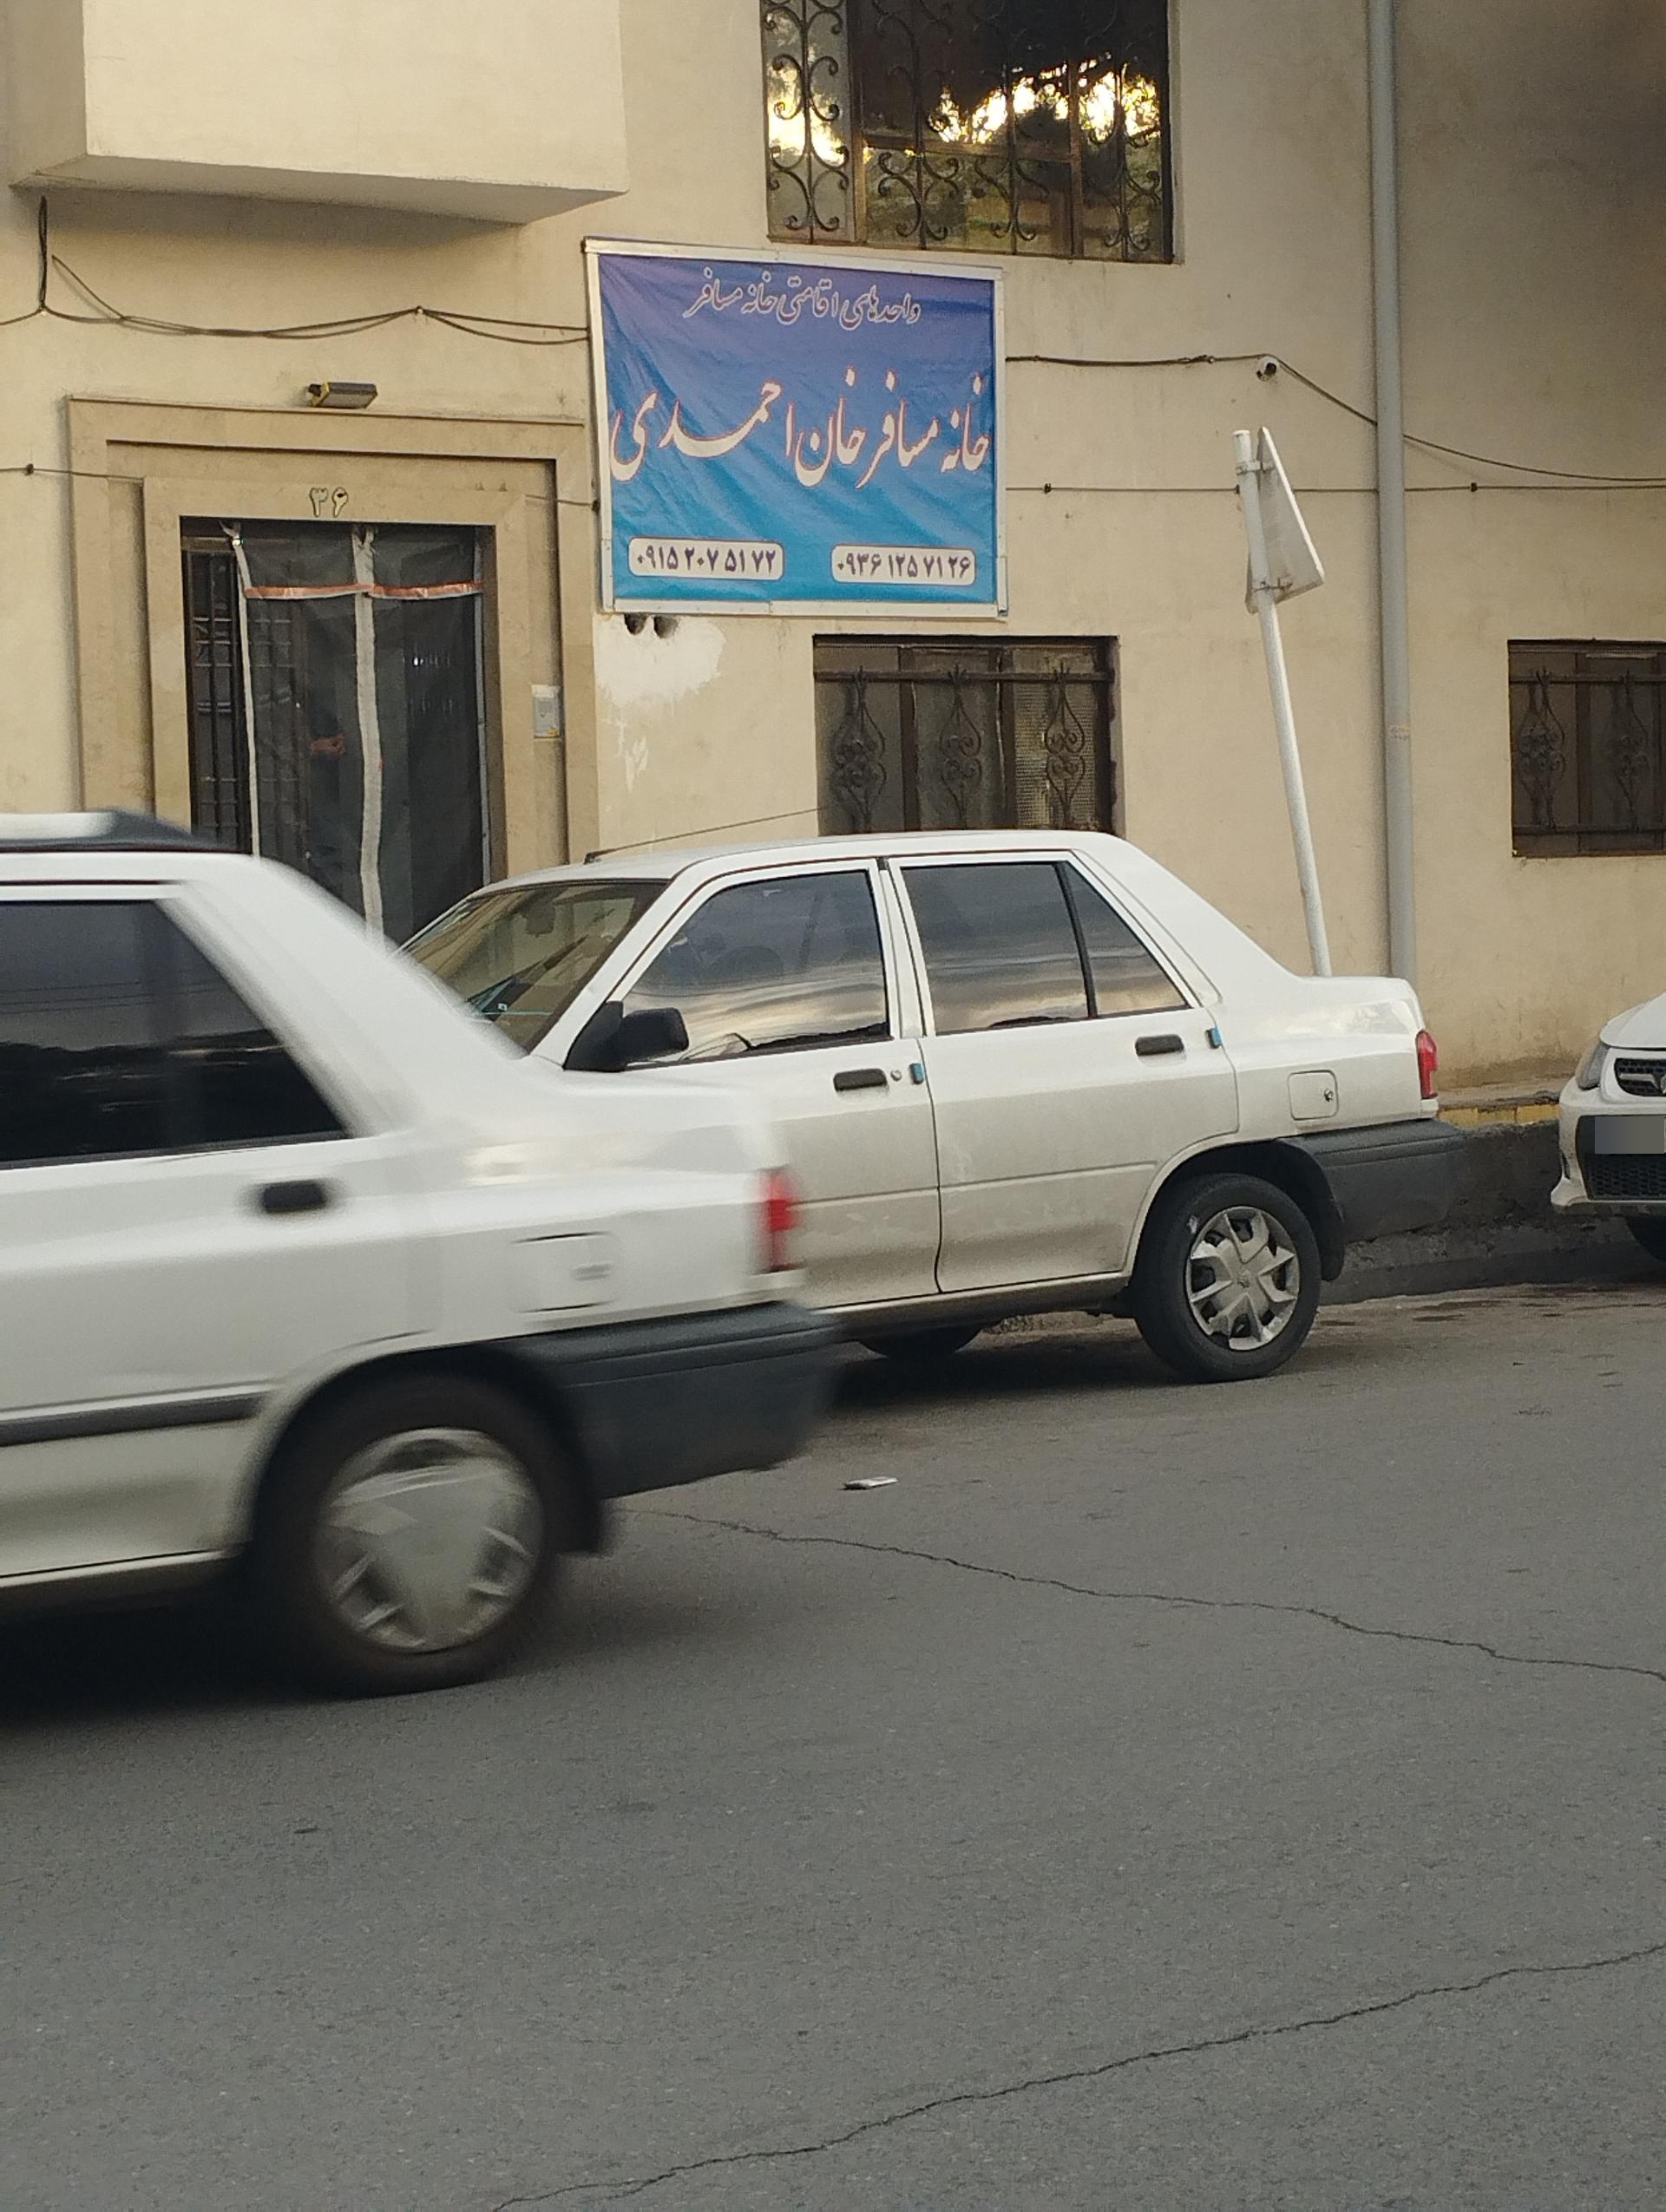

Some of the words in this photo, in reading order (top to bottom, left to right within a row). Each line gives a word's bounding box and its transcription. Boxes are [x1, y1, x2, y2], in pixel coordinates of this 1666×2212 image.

[682, 266, 744, 318] مسافر
[740, 271, 778, 314] خانه
[777, 276, 839, 325] اقامتی
[793, 364, 867, 488] خان
[855, 368, 941, 491] مسافر
[940, 371, 991, 473] خانه
